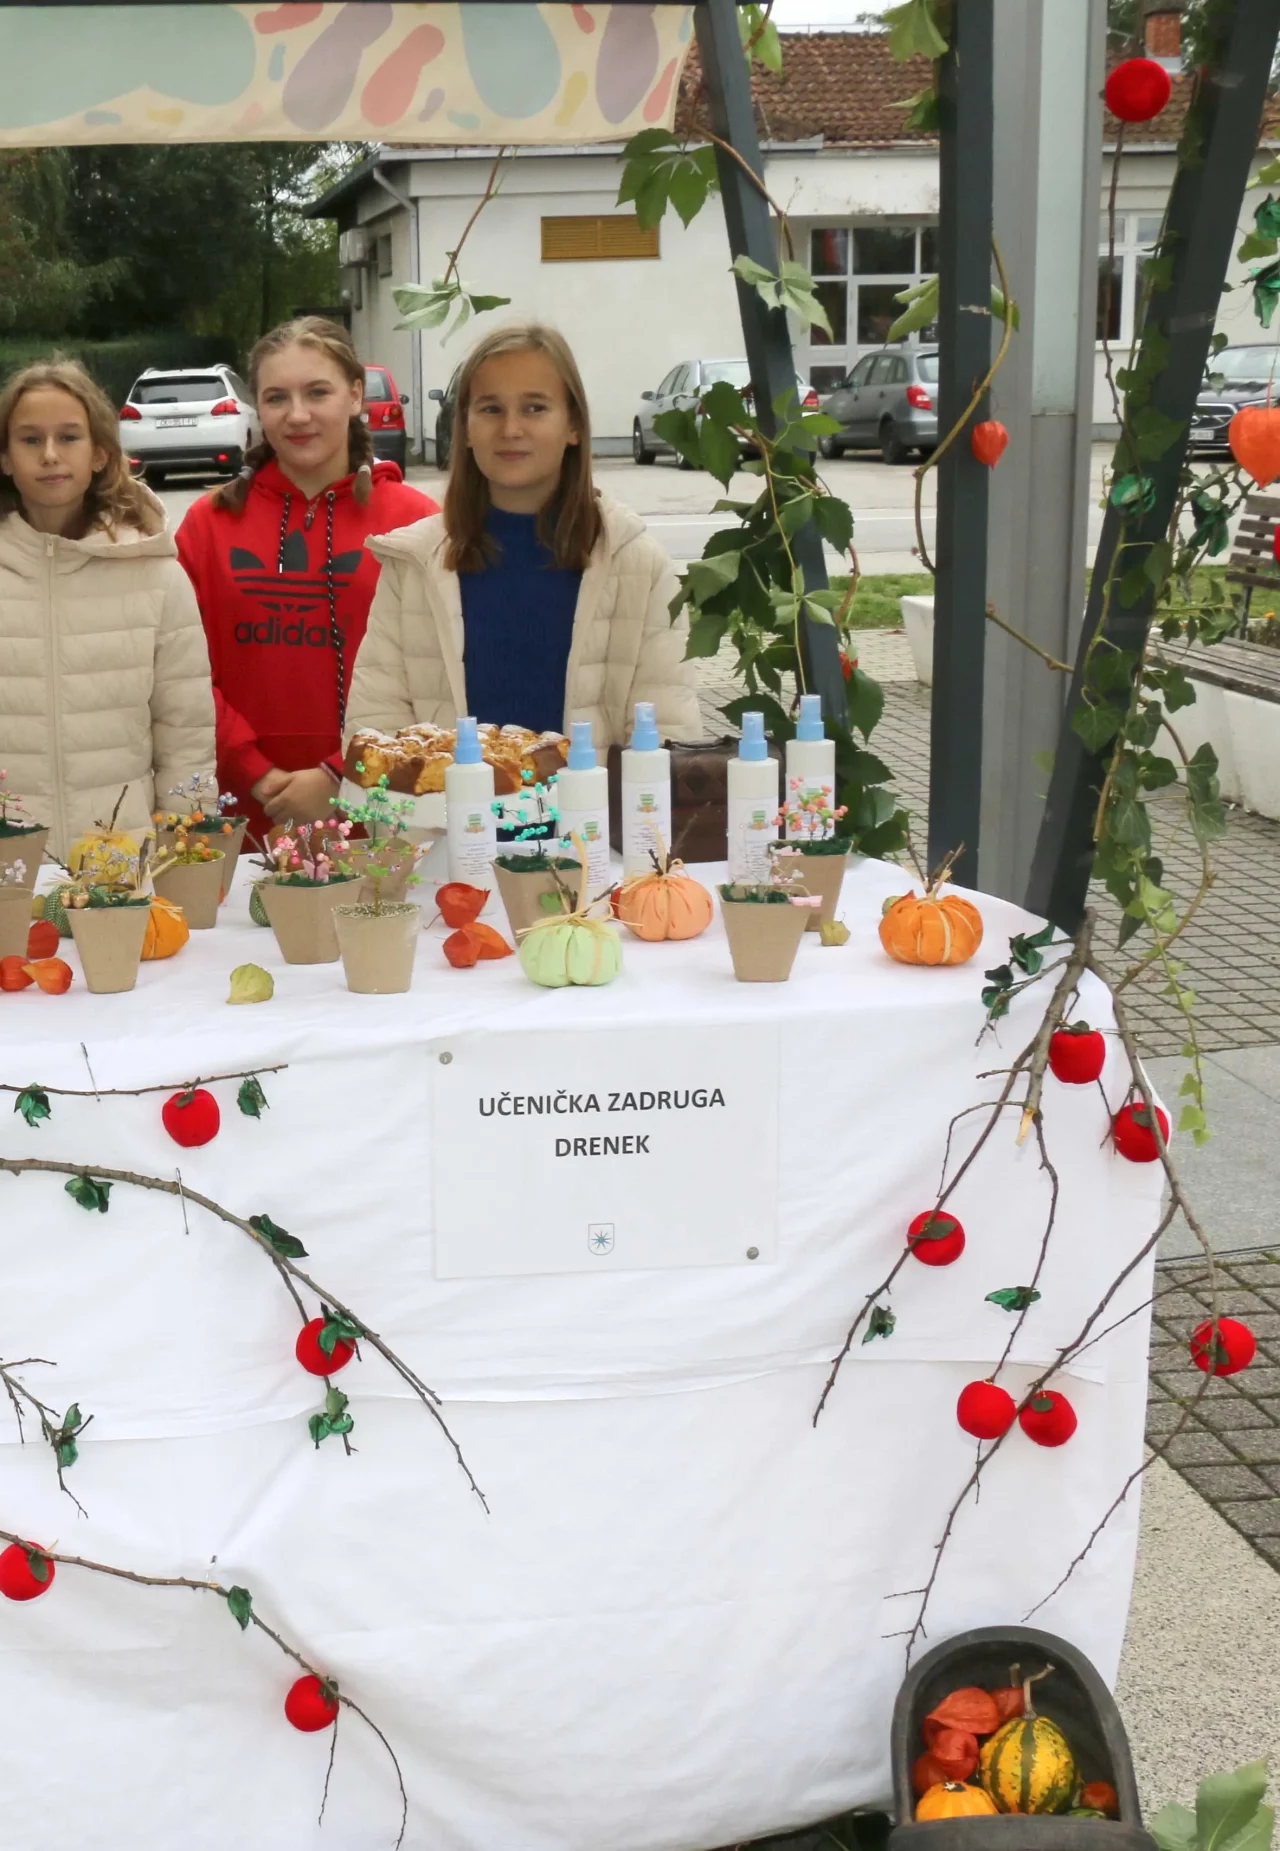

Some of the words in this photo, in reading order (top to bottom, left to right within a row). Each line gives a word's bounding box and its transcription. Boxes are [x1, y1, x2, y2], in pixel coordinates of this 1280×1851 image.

[235, 616, 347, 648] adidas
[478, 1089, 601, 1117] UČENIČKA
[607, 1087, 726, 1112] ZADRUGA
[554, 1134, 651, 1158] DRENEK
